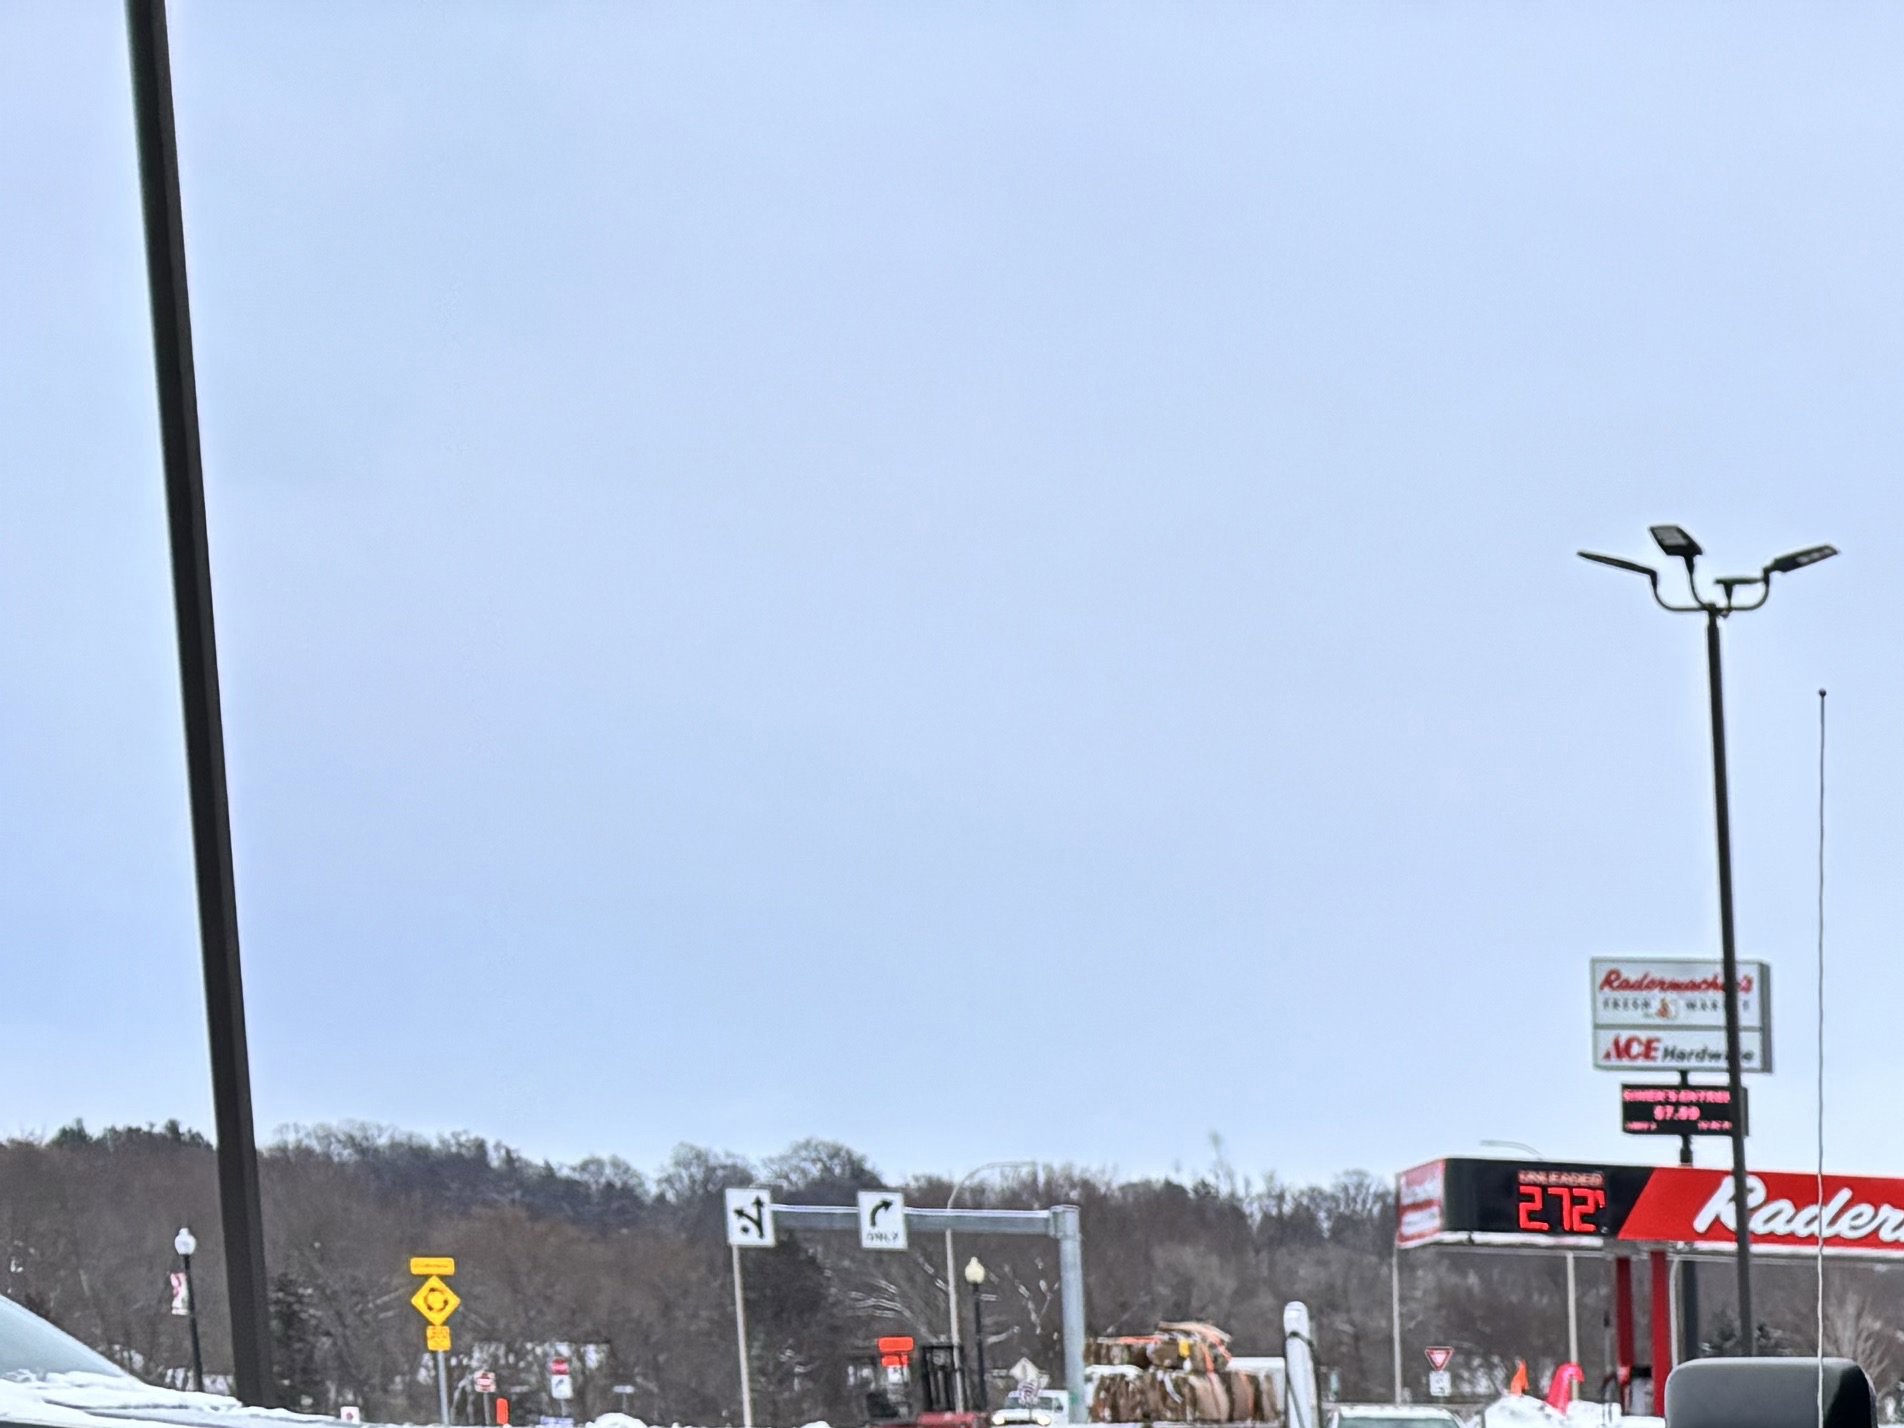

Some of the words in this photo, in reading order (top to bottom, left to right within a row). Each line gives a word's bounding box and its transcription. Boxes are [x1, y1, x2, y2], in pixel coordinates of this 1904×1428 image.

[1600, 968, 1753, 993] Radermach's
[1603, 1034, 1661, 1061] ACE
[1662, 1045, 1754, 1062] Hardwe
